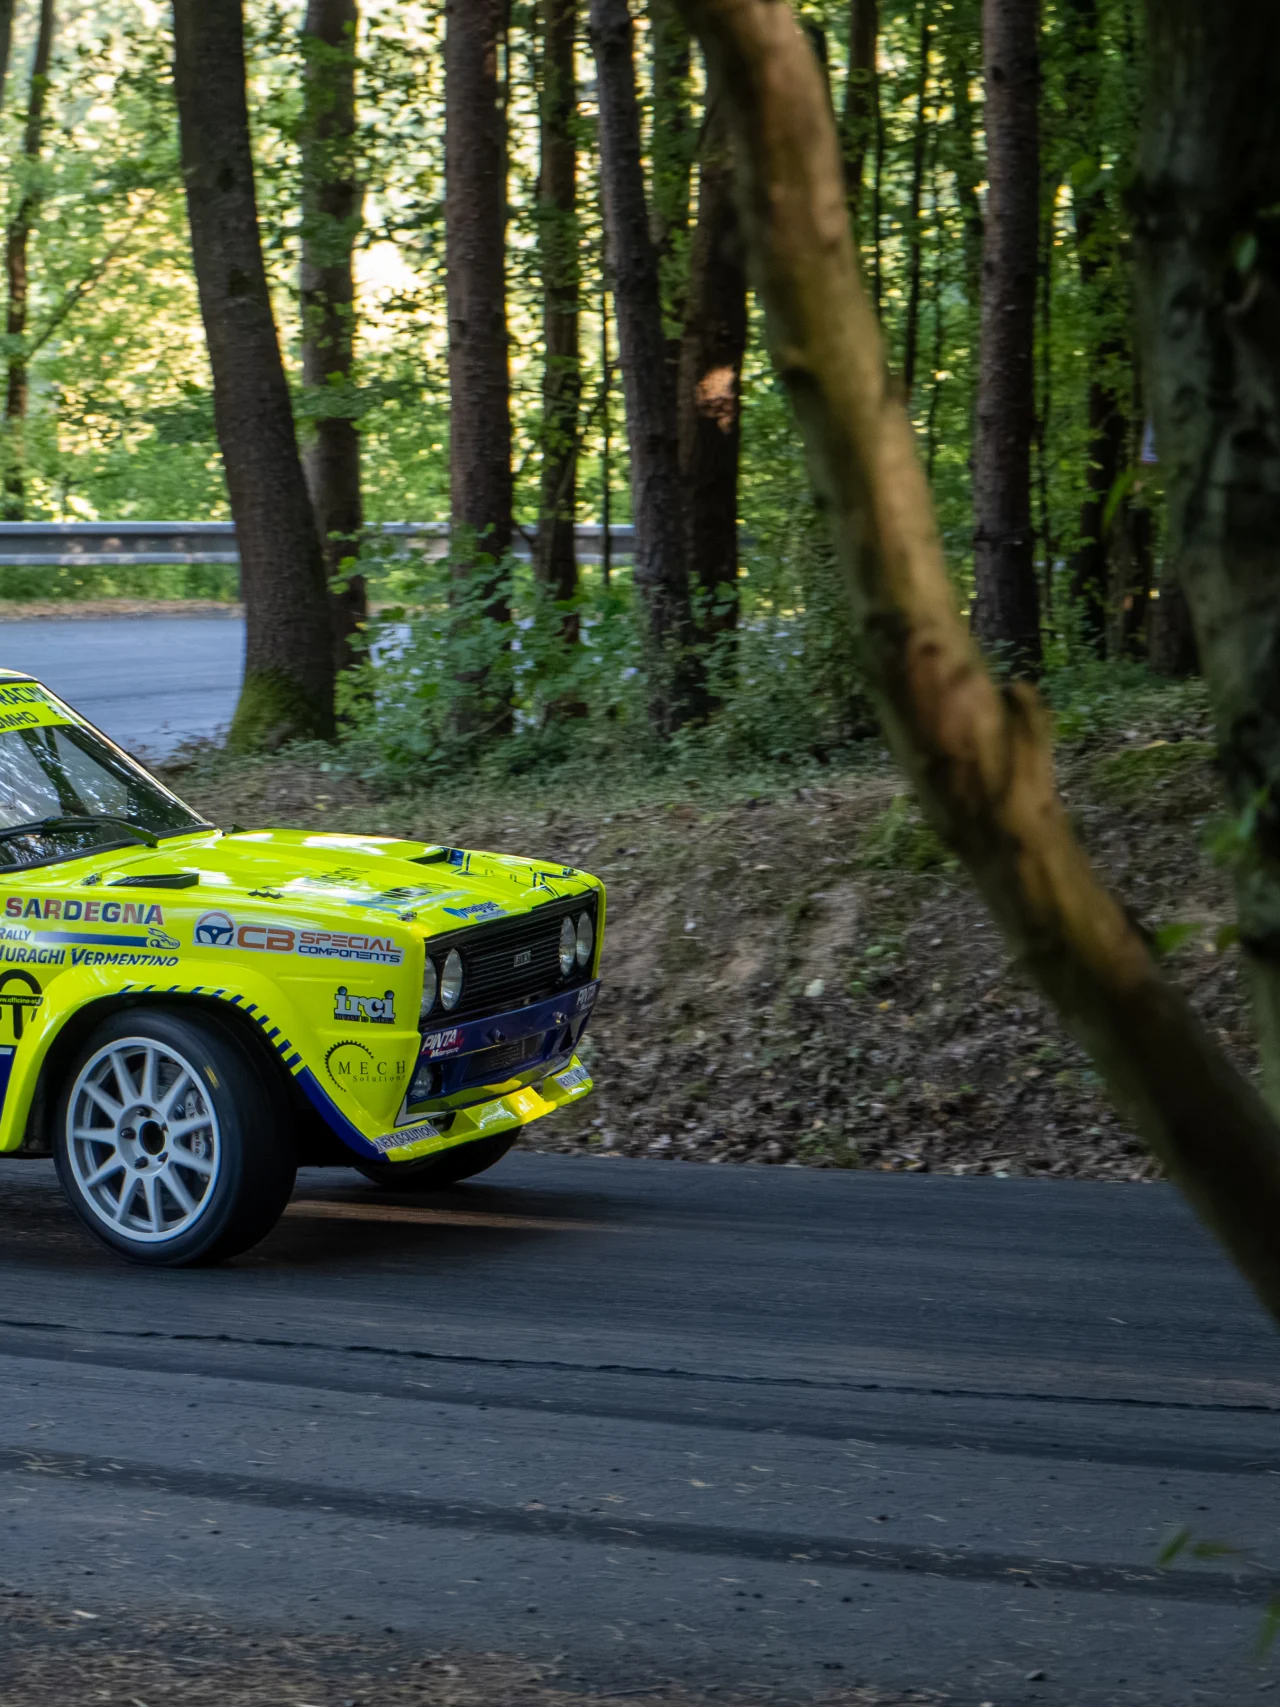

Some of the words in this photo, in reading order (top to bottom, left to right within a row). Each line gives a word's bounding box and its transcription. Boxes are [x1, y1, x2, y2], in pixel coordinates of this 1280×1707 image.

[5, 897, 165, 926] SARDEGNA
[237, 926, 296, 952] CB
[299, 932, 404, 954] SPECIAL
[70, 945, 180, 967] VERMENTINO
[298, 945, 401, 964] COMPONENTS
[421, 1029, 457, 1052] PINTA
[338, 1060, 406, 1076] MECH
